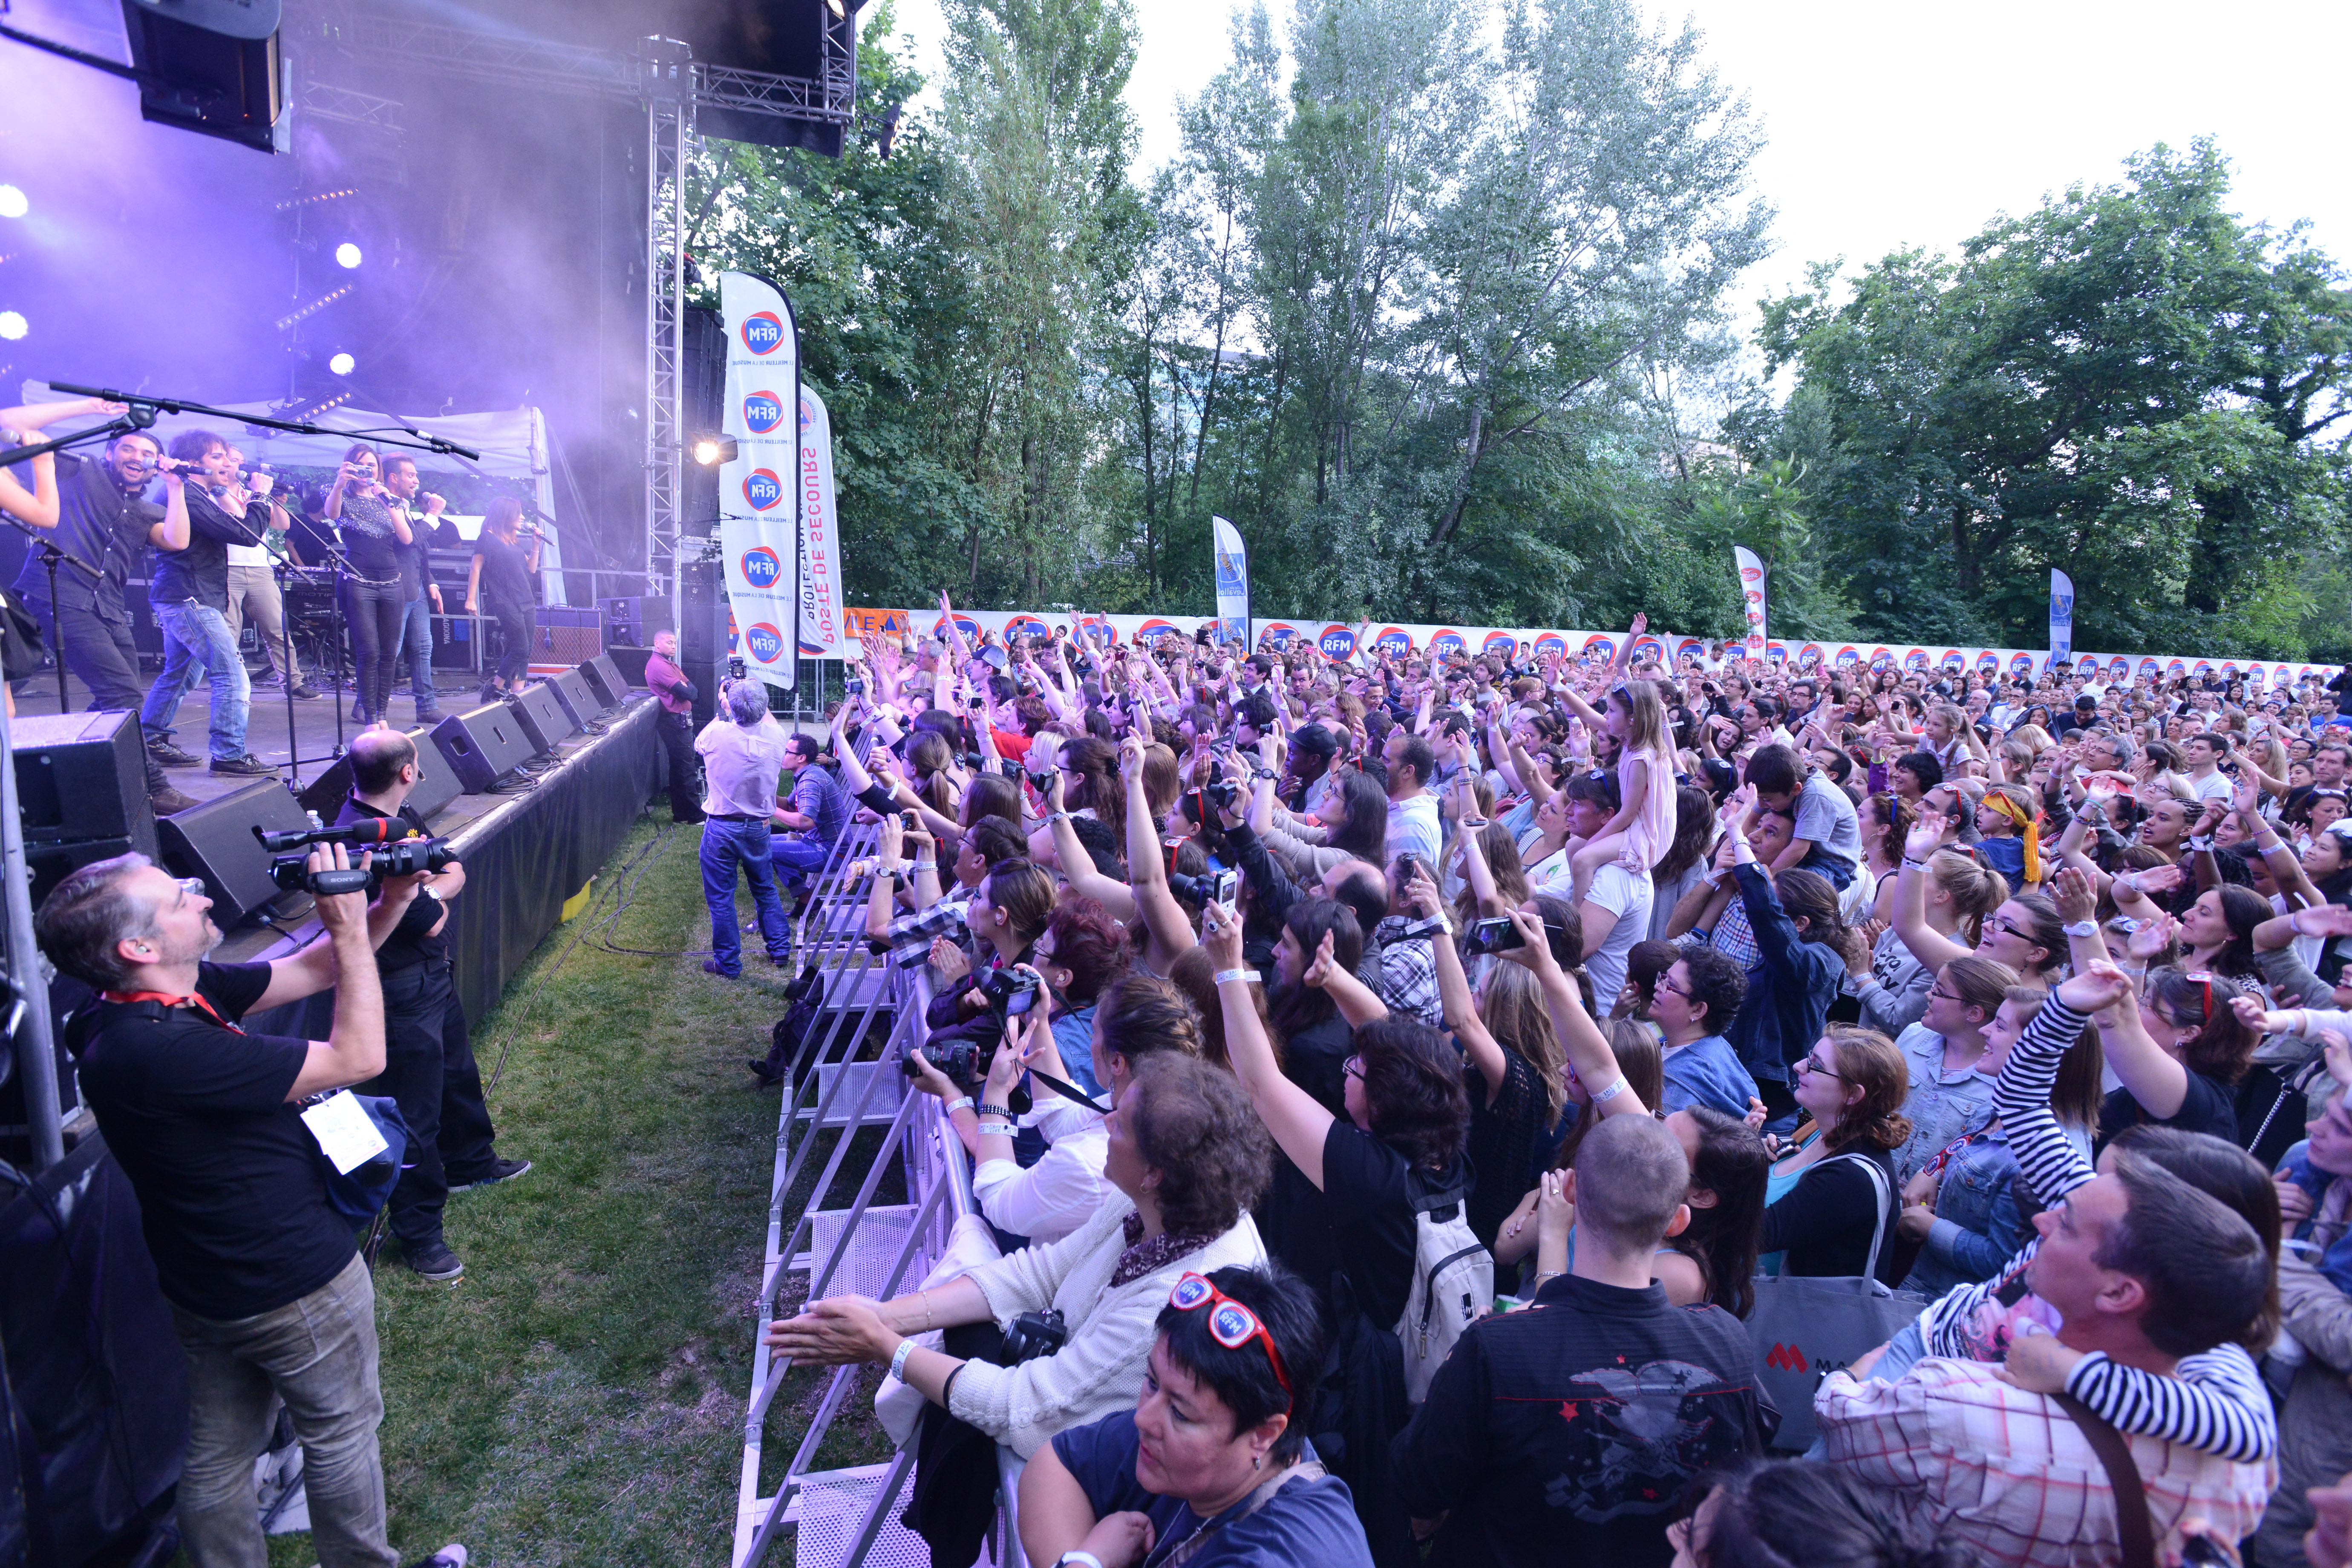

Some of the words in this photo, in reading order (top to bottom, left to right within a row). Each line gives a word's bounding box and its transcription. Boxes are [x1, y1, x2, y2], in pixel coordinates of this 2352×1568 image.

[1323, 639, 1350, 651] RFM
[1908, 660, 1919, 669] RF
[2080, 666, 2095, 674] RFM
[1950, 1141, 1962, 1151] RFM
[1180, 1284, 1200, 1298] RFM
[1219, 1311, 1242, 1334] RFM
